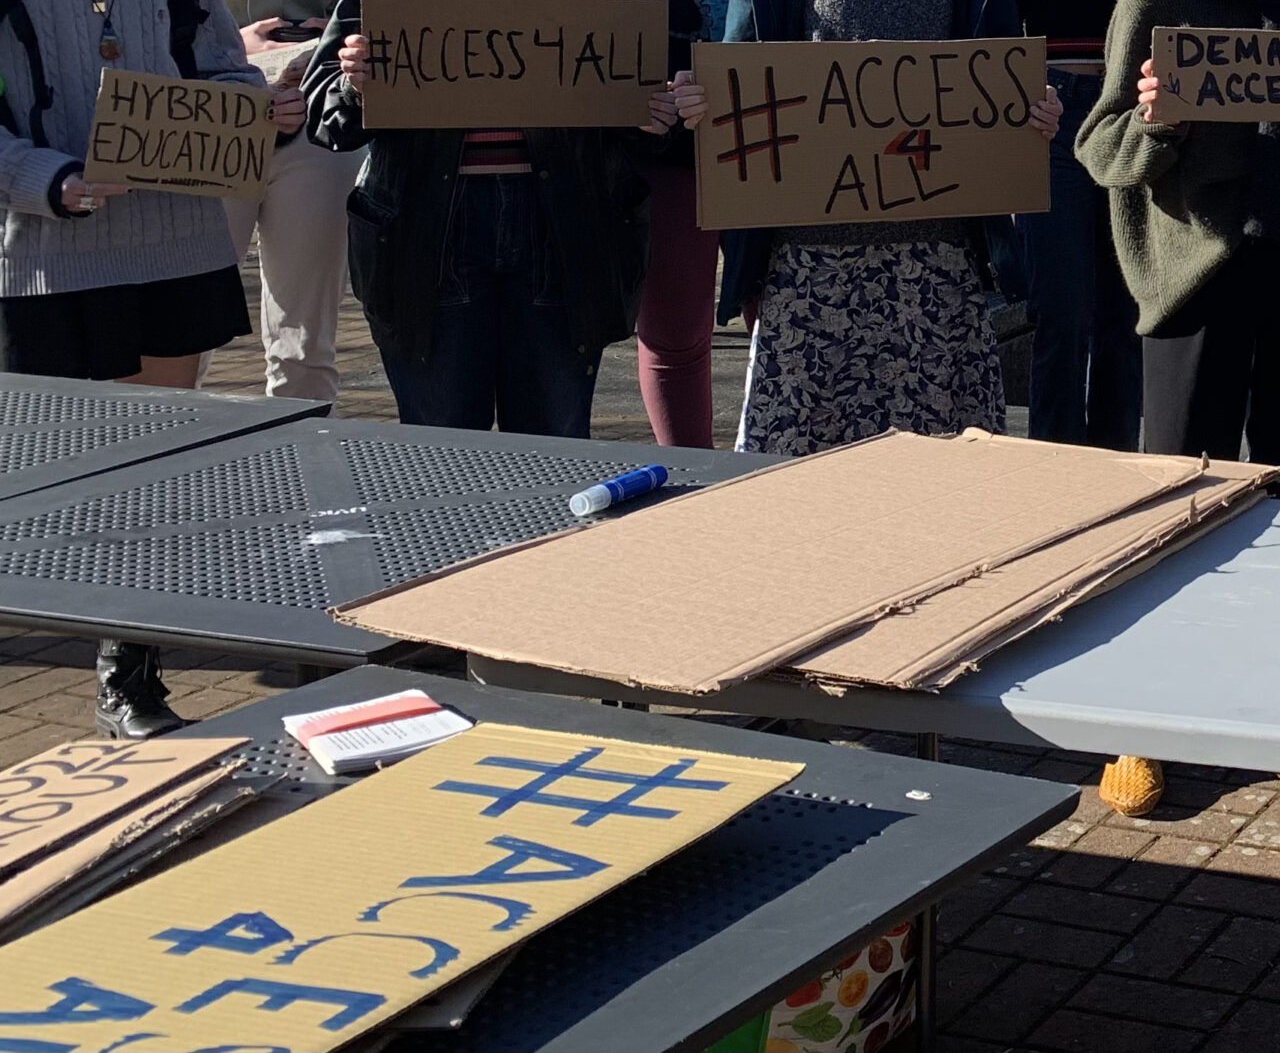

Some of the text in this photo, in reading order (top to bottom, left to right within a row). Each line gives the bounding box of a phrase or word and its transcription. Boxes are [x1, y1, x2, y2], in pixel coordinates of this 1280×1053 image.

[111, 78, 256, 128] HYBRID
[93, 122, 265, 182] EDUCATION
[883, 129, 942, 171] 4
[825, 153, 959, 214] ALL
[0, 741, 145, 800] 022
[148, 911, 294, 956] 4
